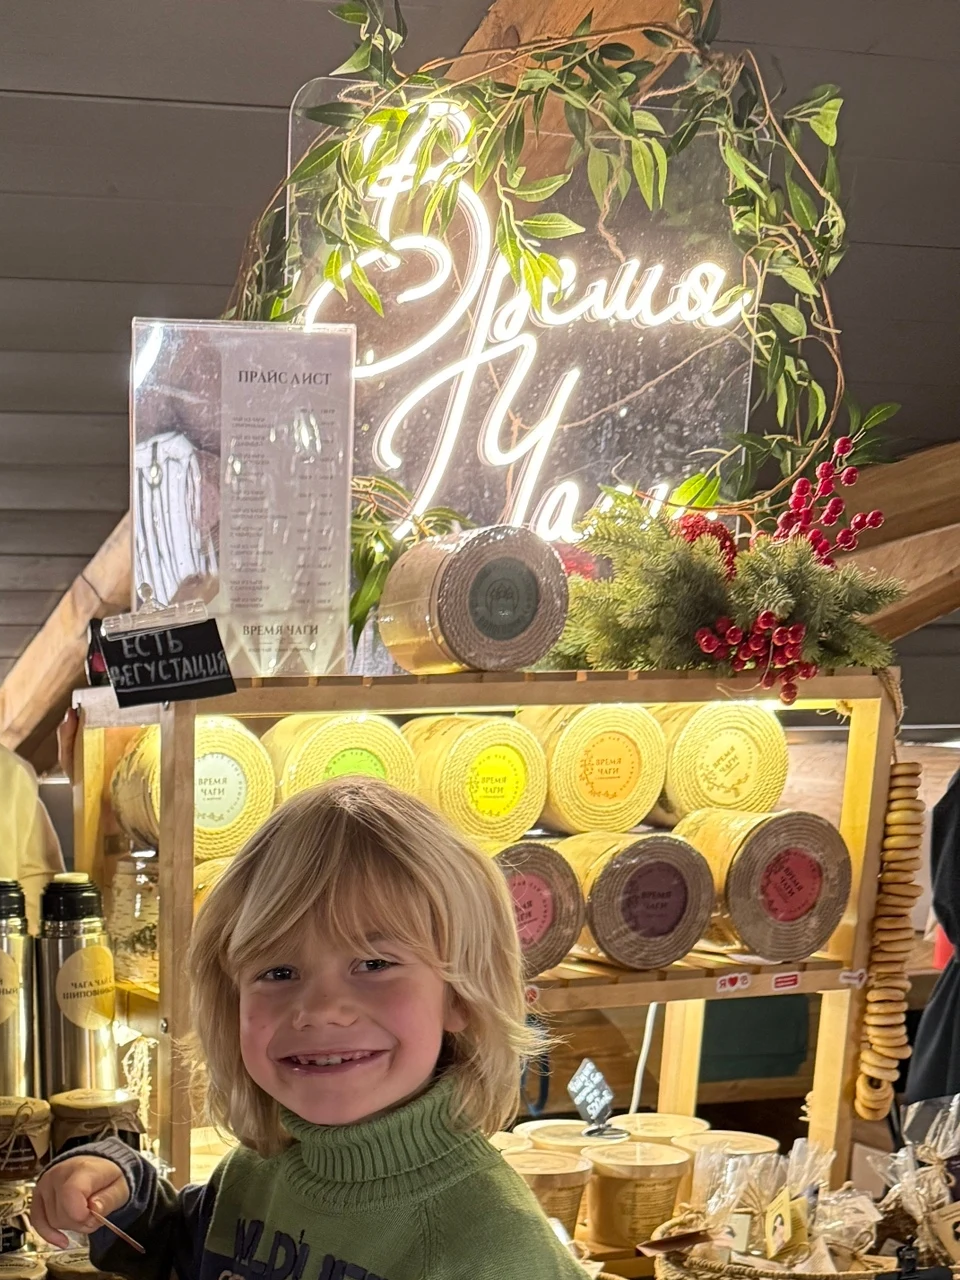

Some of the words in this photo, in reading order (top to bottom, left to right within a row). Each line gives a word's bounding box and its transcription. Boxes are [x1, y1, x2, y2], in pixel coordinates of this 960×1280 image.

[238, 370, 287, 383] ПРАЙС
[290, 372, 331, 385] ЛИСТ
[243, 624, 283, 636] ВРЕМЯ
[287, 624, 318, 635] ЧАГИ
[122, 630, 184, 659] ЕСТЬ
[110, 650, 229, 688] ДЕГУСТАЦИЯ
[198, 777, 228, 786] ВРЕМЯ
[201, 788, 225, 797] ЧАГИ
[70, 979, 93, 990] ЧАГА
